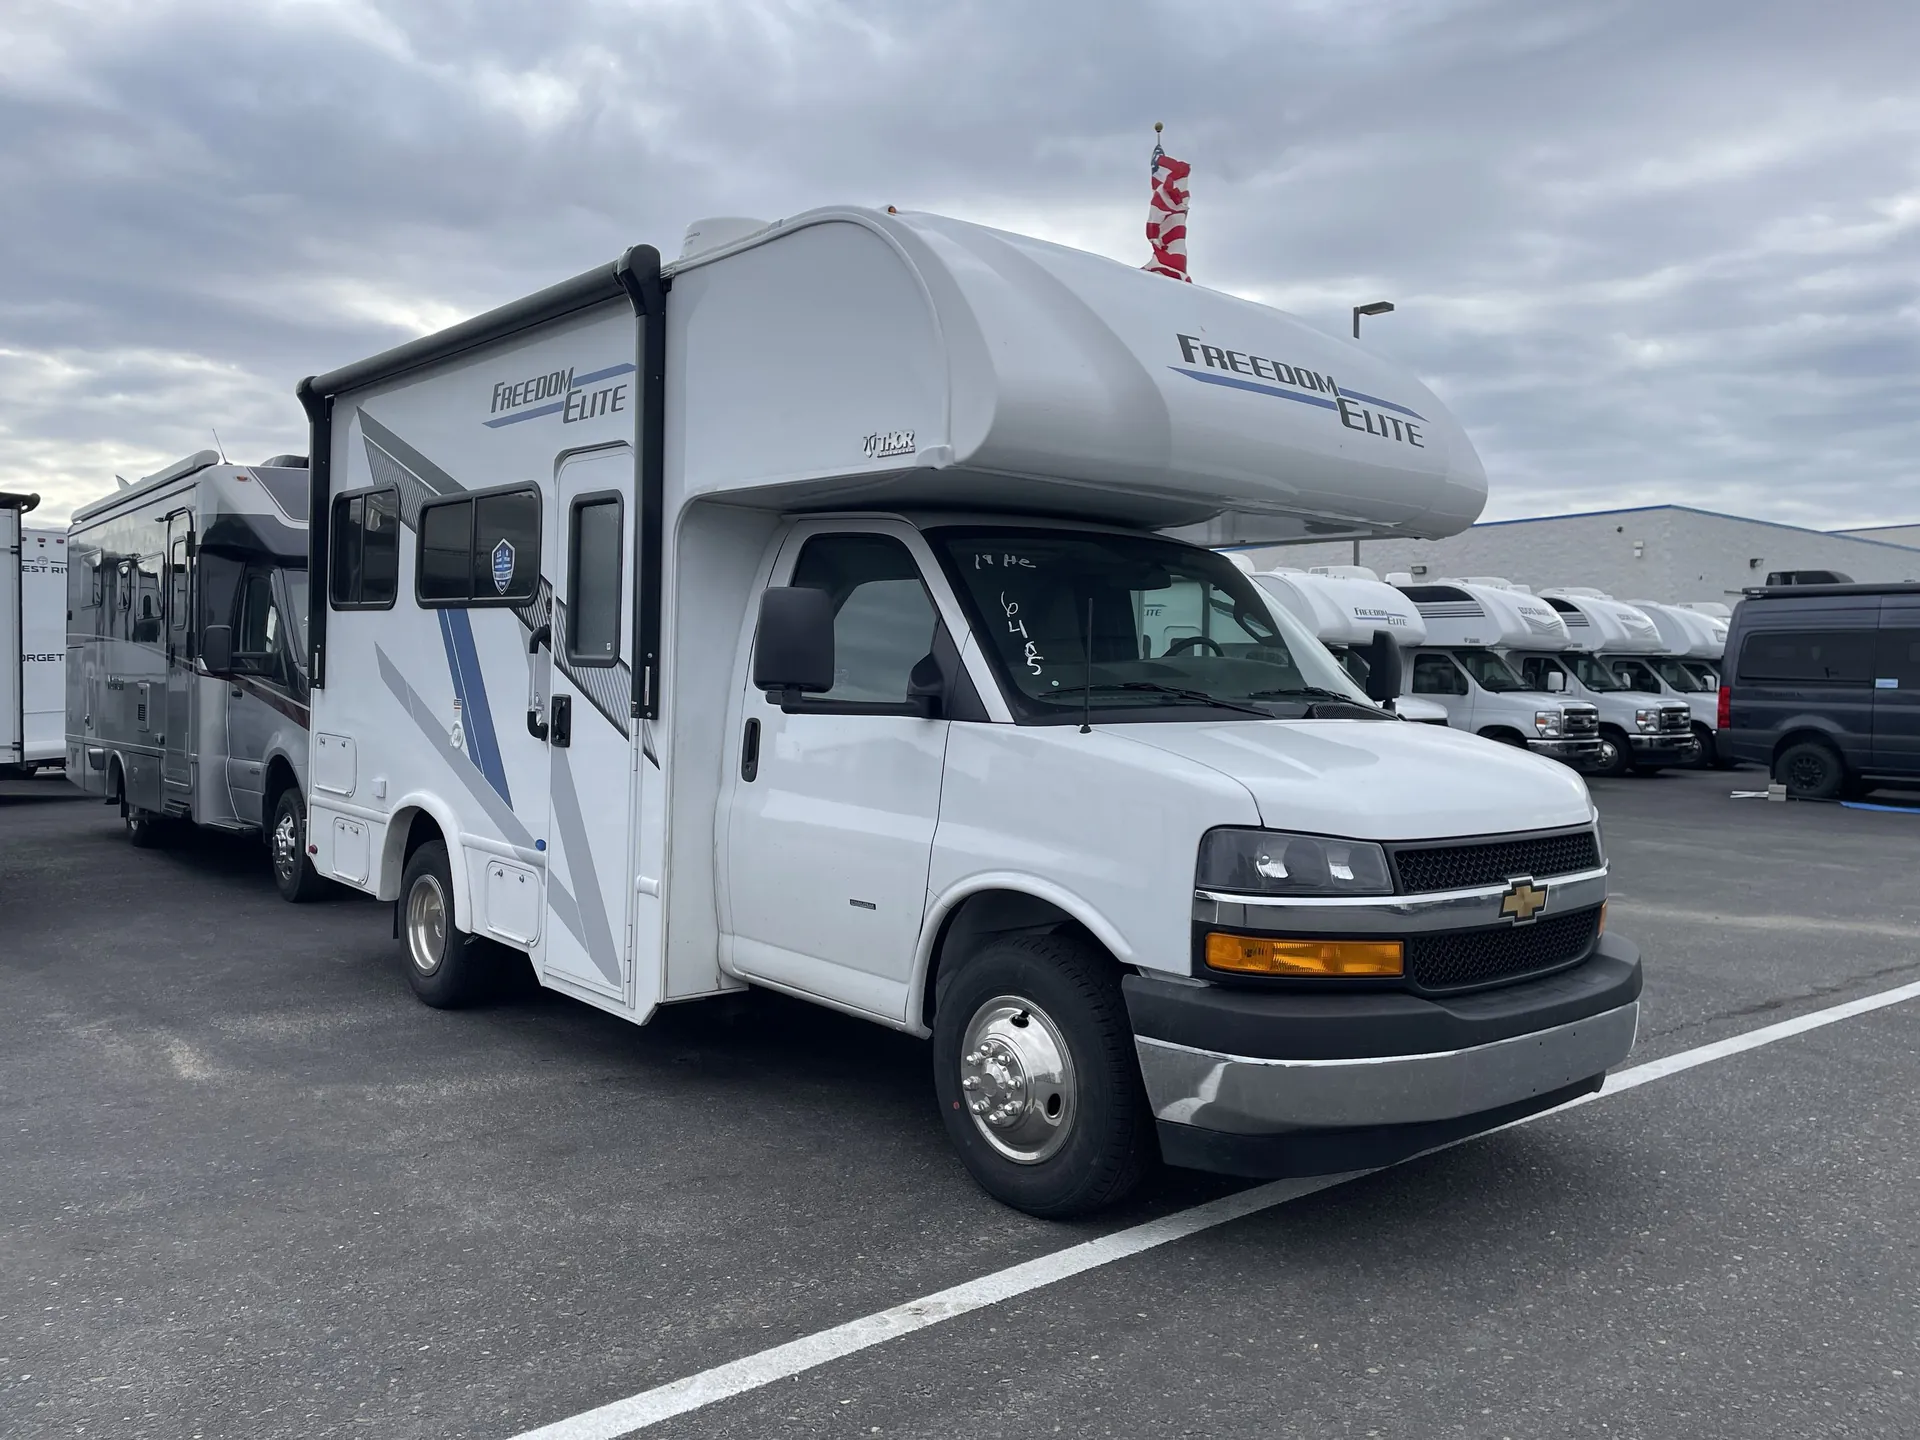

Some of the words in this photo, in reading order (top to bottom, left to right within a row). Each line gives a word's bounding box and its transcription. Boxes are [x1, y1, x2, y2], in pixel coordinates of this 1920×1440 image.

[1176, 333, 1341, 398] FREEDOM
[490, 366, 575, 414] FREEDOM
[562, 384, 628, 424] ELITE
[877, 430, 916, 453] THOR
[1336, 396, 1425, 449] ELITE
[1354, 607, 1388, 616] FREEDOM
[1387, 615, 1408, 627] ELITE
